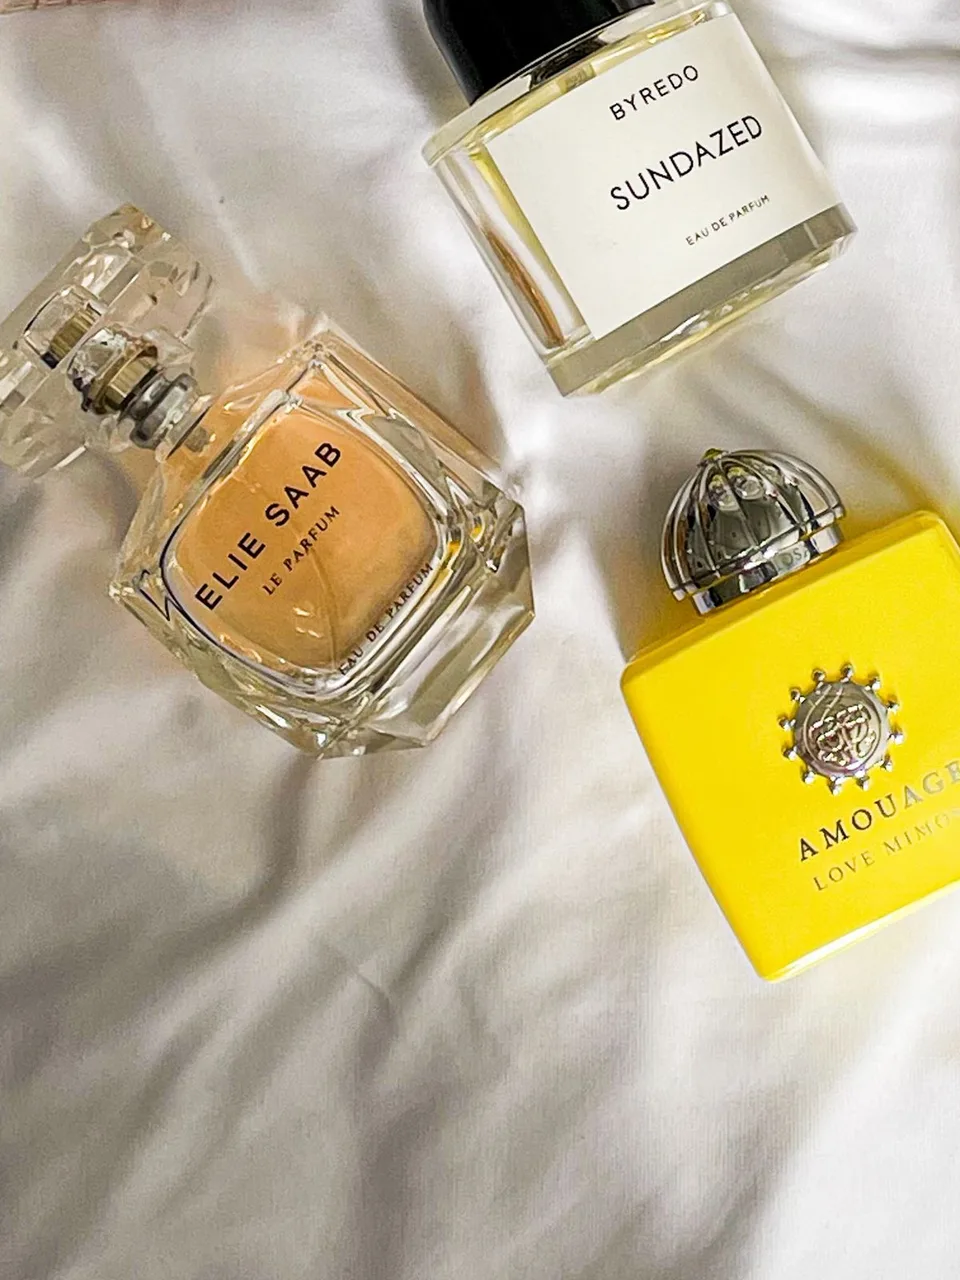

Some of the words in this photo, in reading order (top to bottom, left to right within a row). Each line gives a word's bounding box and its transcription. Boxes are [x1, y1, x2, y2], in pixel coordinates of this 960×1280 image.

[609, 65, 699, 121] BYREDO
[610, 115, 762, 211] SUNDAZED
[685, 227, 710, 246] EAU
[710, 216, 728, 232] DE
[728, 194, 770, 223] PARFUM
[194, 532, 266, 611] ELIE
[264, 442, 341, 528] SAAB
[261, 572, 284, 596] LE
[282, 505, 340, 572] PARFUM
[365, 622, 385, 643] DE
[385, 562, 434, 620] PARFUM
[812, 851, 876, 892] LOVE
